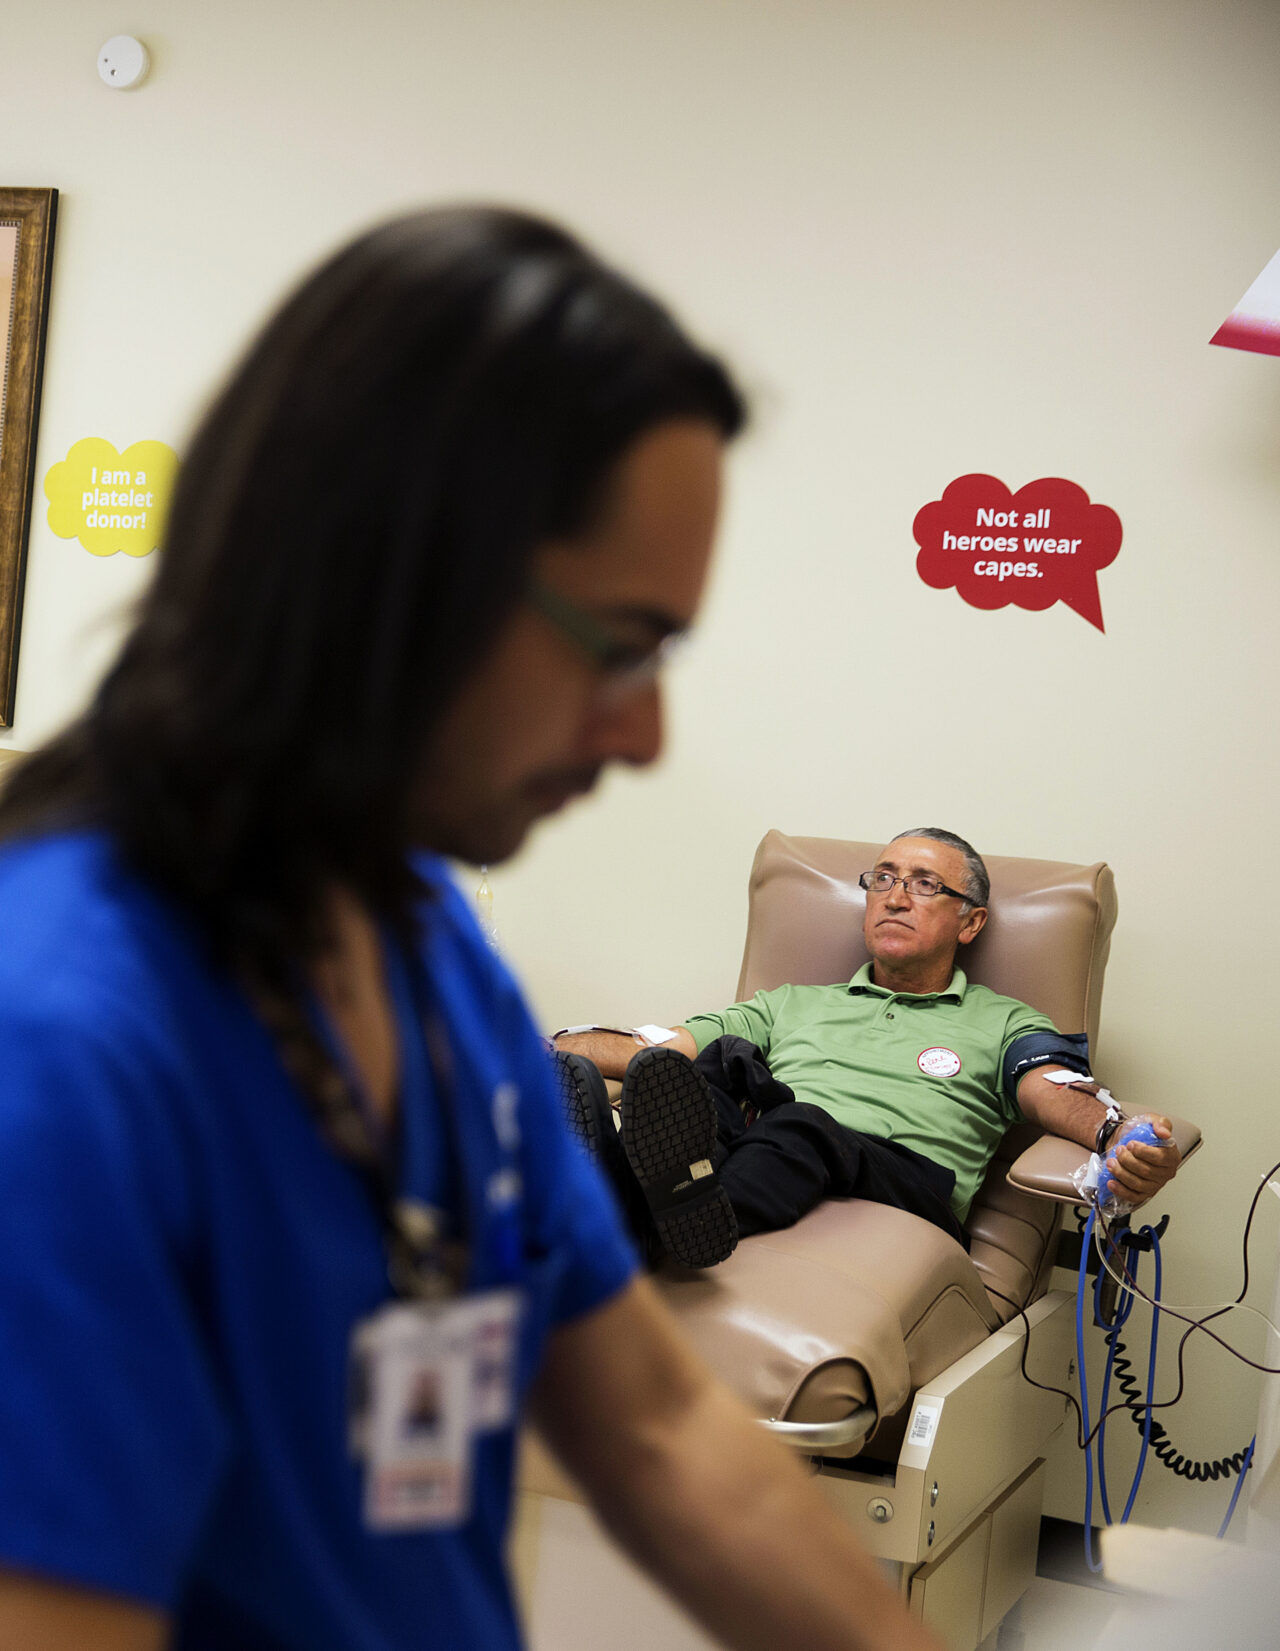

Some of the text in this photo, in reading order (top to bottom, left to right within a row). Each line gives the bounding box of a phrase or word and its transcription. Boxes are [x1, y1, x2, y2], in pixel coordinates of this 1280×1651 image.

[91, 467, 147, 485] I am a
[82, 488, 154, 511] platelet
[86, 510, 147, 529] donor!
[976, 508, 1051, 529] Not all
[942, 531, 1082, 554] heroes wear
[973, 560, 1044, 581] capes.
